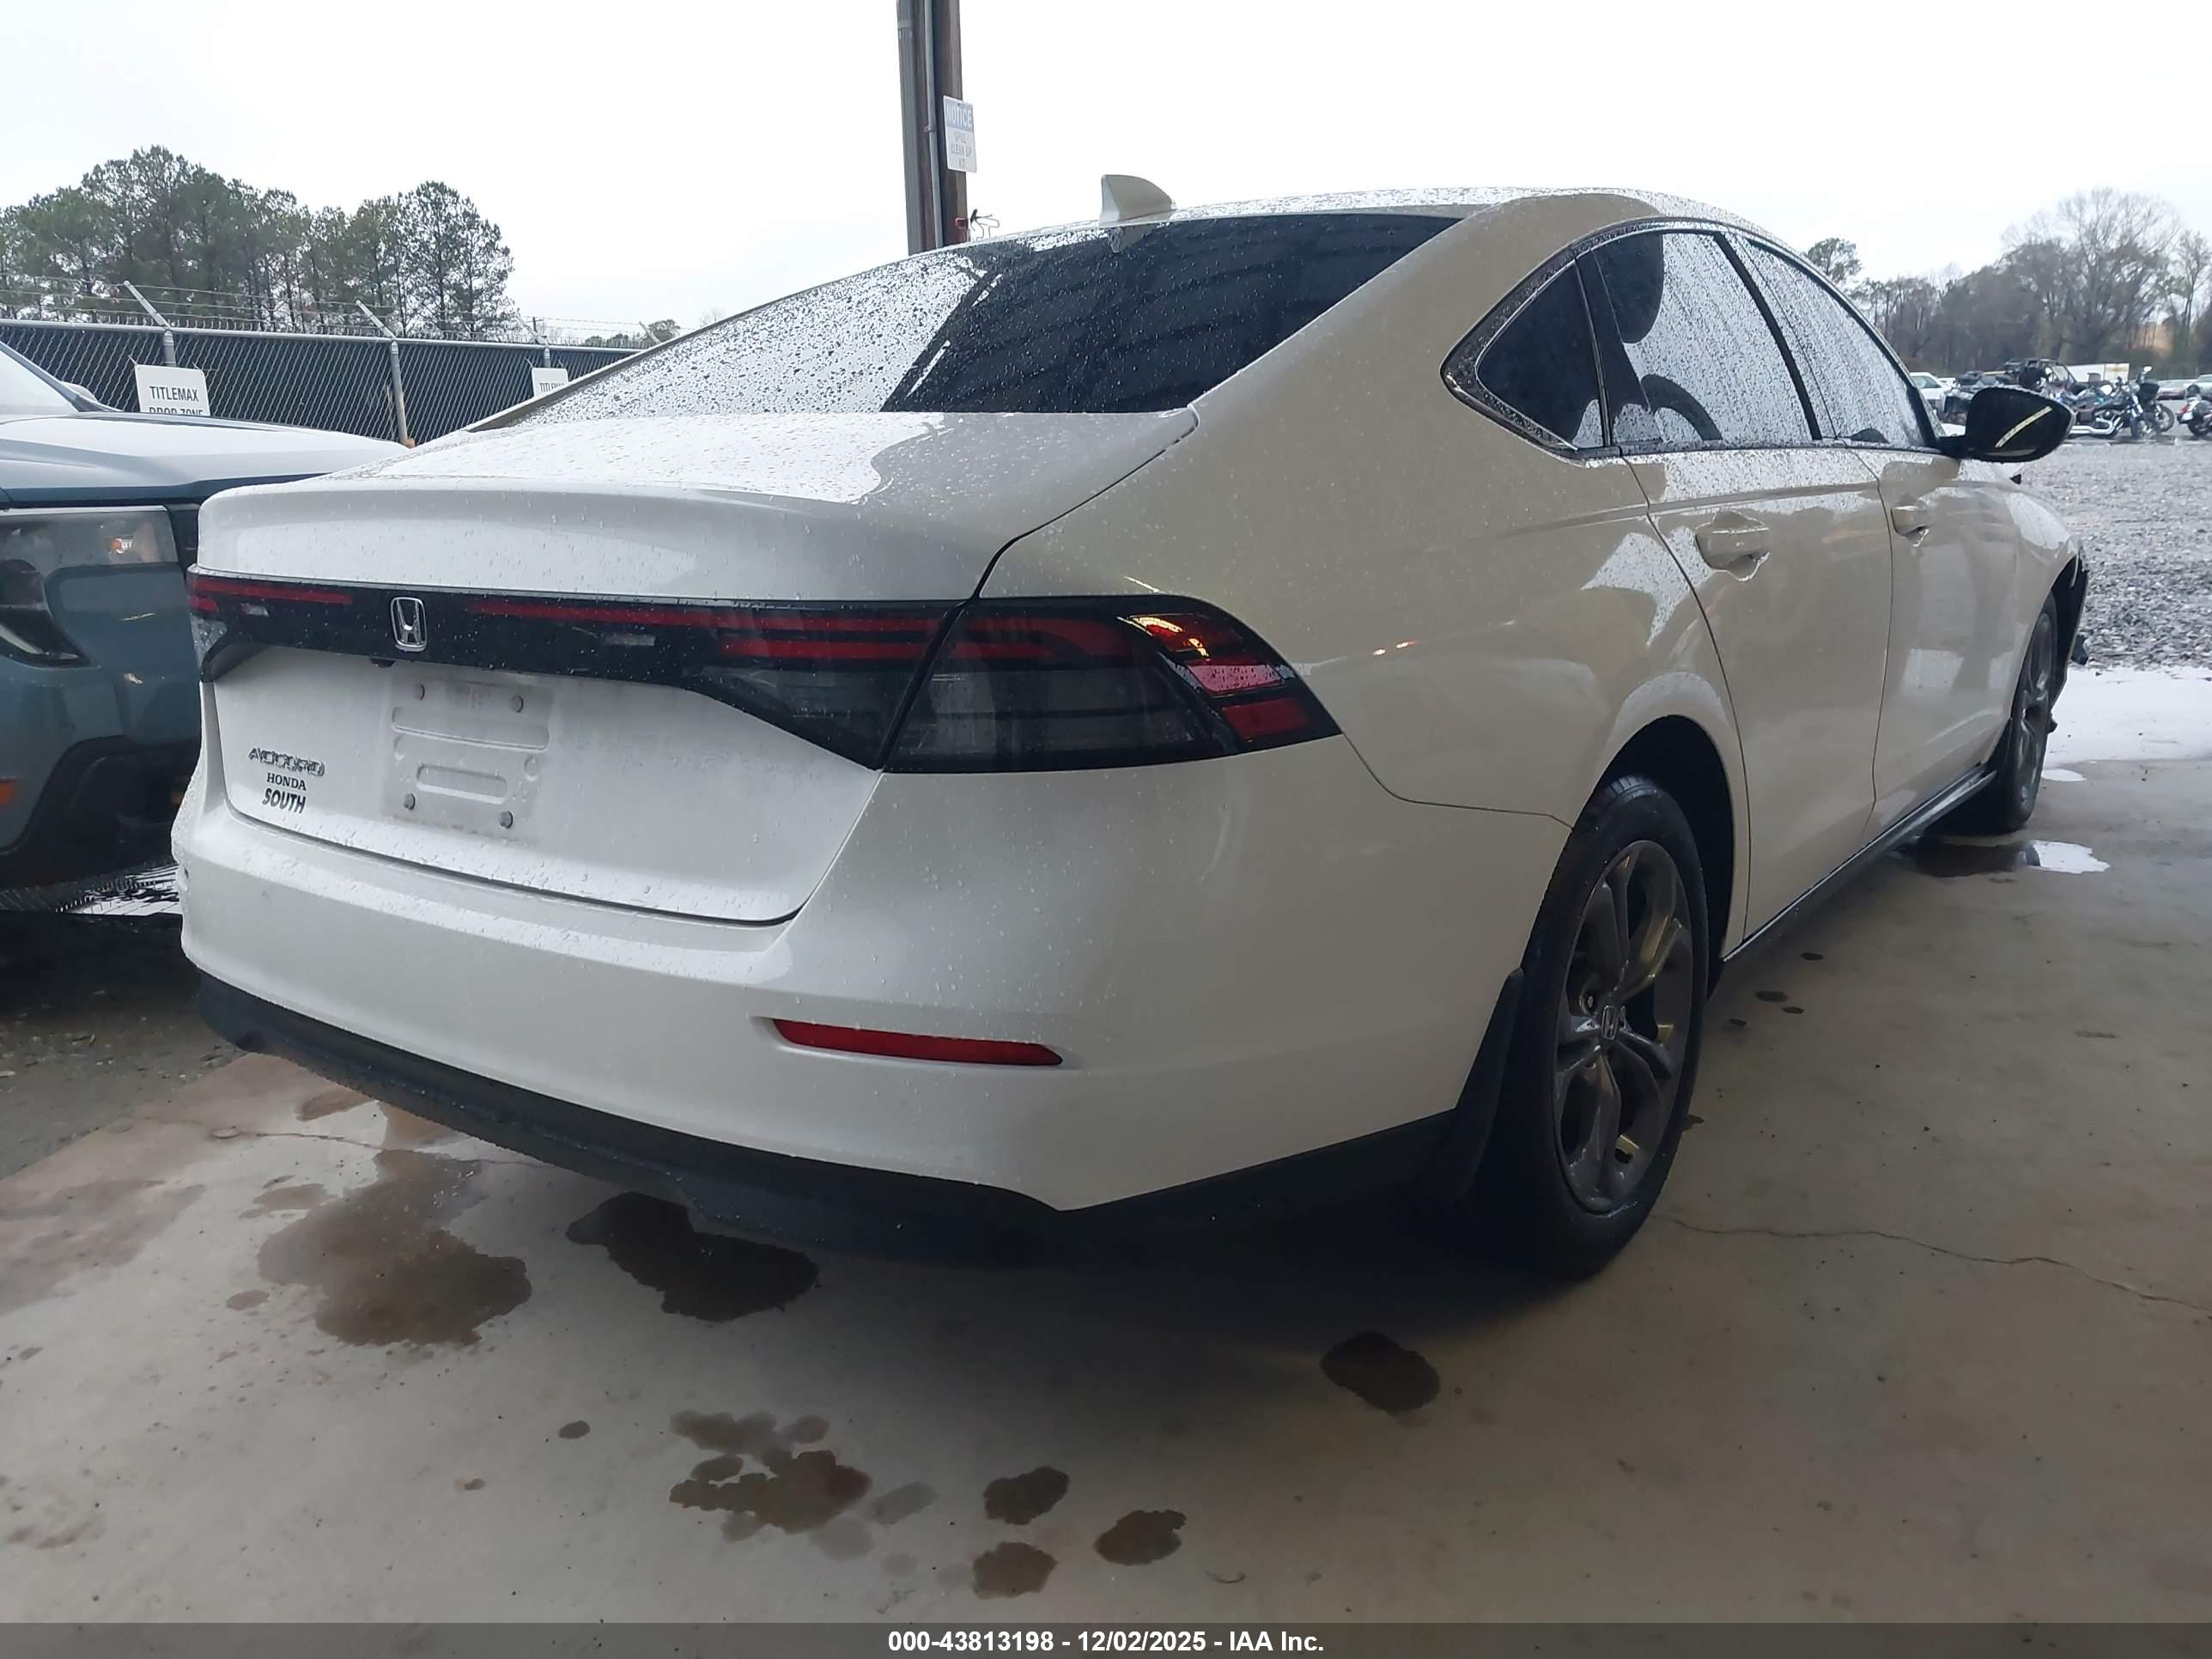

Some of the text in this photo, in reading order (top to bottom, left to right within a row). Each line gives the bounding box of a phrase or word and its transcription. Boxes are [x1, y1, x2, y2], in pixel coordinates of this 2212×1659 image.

[945, 105, 973, 129] NOTICE
[149, 386, 199, 402] TITLEMAX
[248, 747, 325, 777] ACCORD
[266, 772, 307, 791] HONDA
[261, 787, 307, 814] SOUTH
